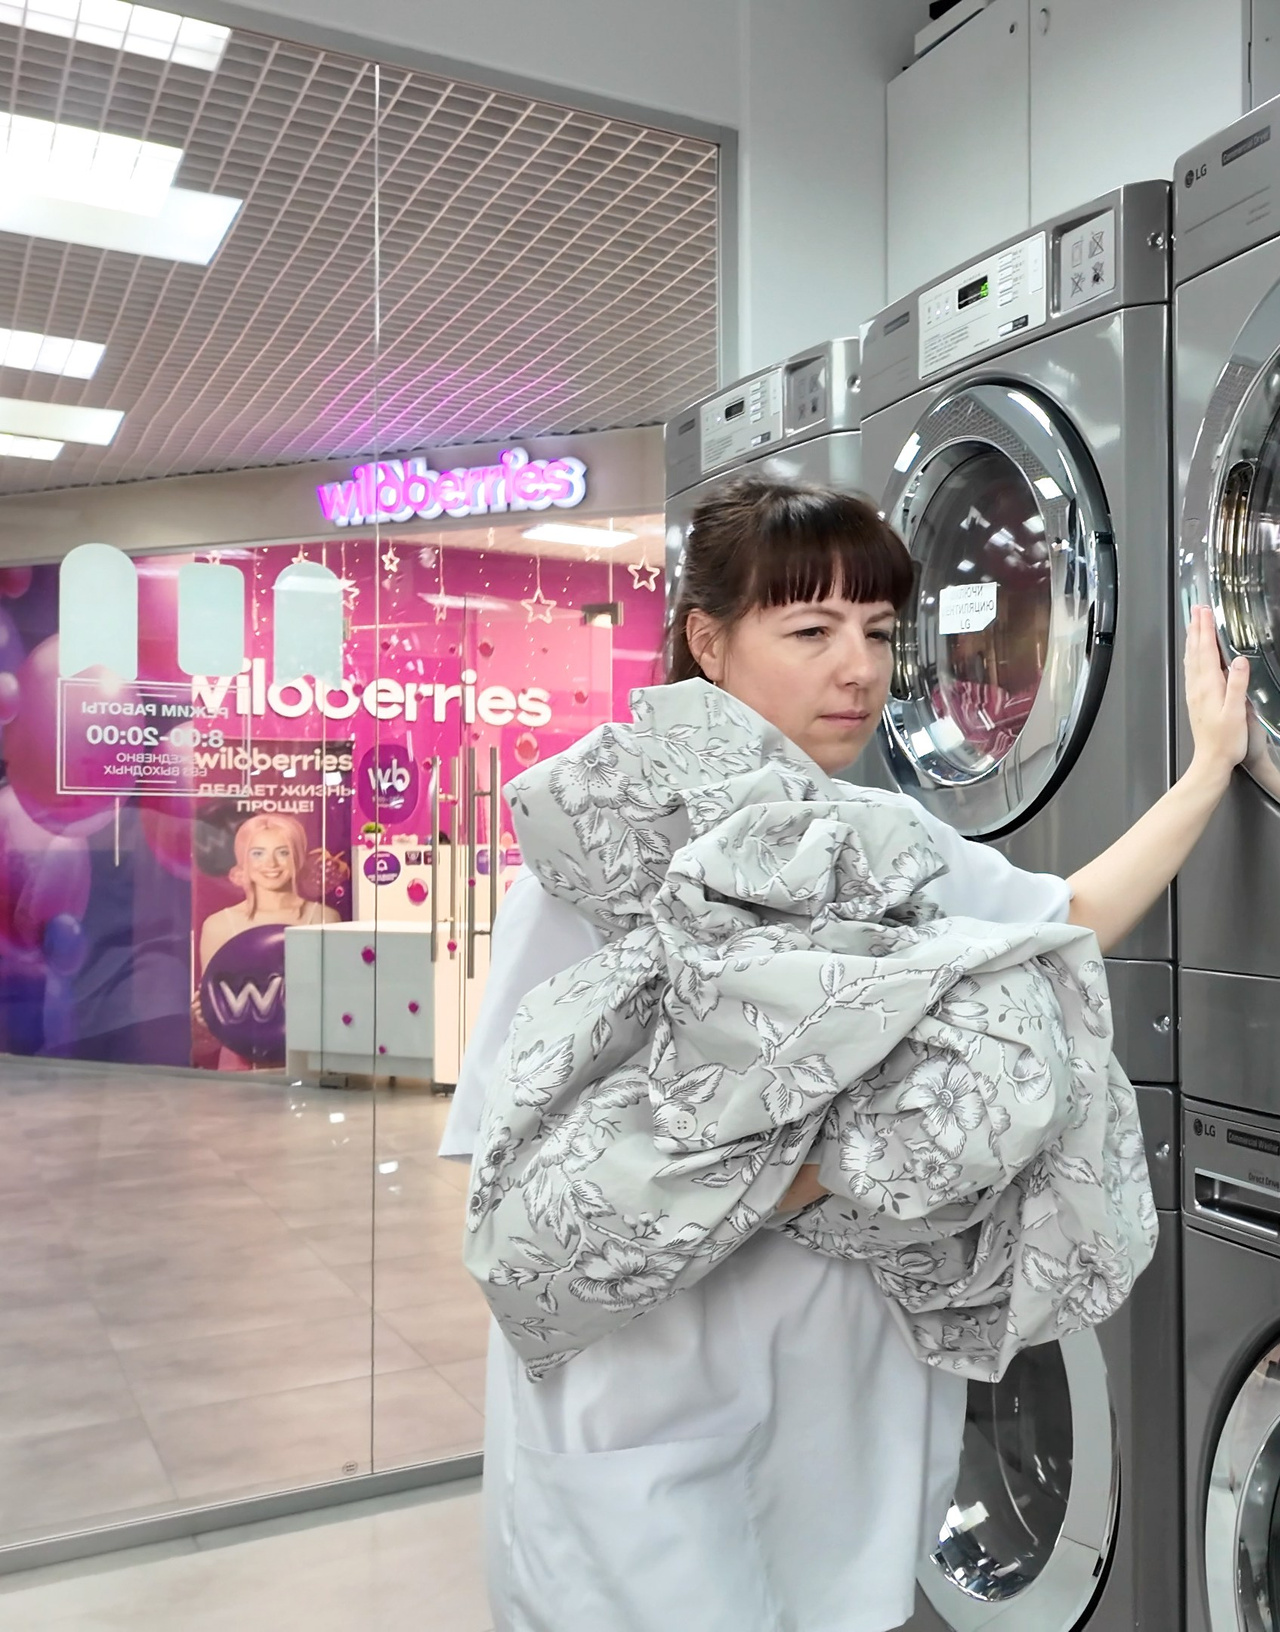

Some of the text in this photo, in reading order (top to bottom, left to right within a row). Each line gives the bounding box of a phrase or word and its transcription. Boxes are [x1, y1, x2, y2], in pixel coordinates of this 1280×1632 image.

[1195, 164, 1207, 180] LG
[317, 447, 588, 527] wildberries
[943, 600, 994, 616] ЕНТИЛЯЦИЮ
[960, 619, 971, 630] LG
[194, 746, 353, 772] wildberries
[367, 758, 411, 793] wb
[199, 783, 351, 798] ДЕЛАЕТ ЖИЗНЬ
[237, 800, 315, 814] ПРОЩЕ!
[1204, 1124, 1216, 1137] LG
